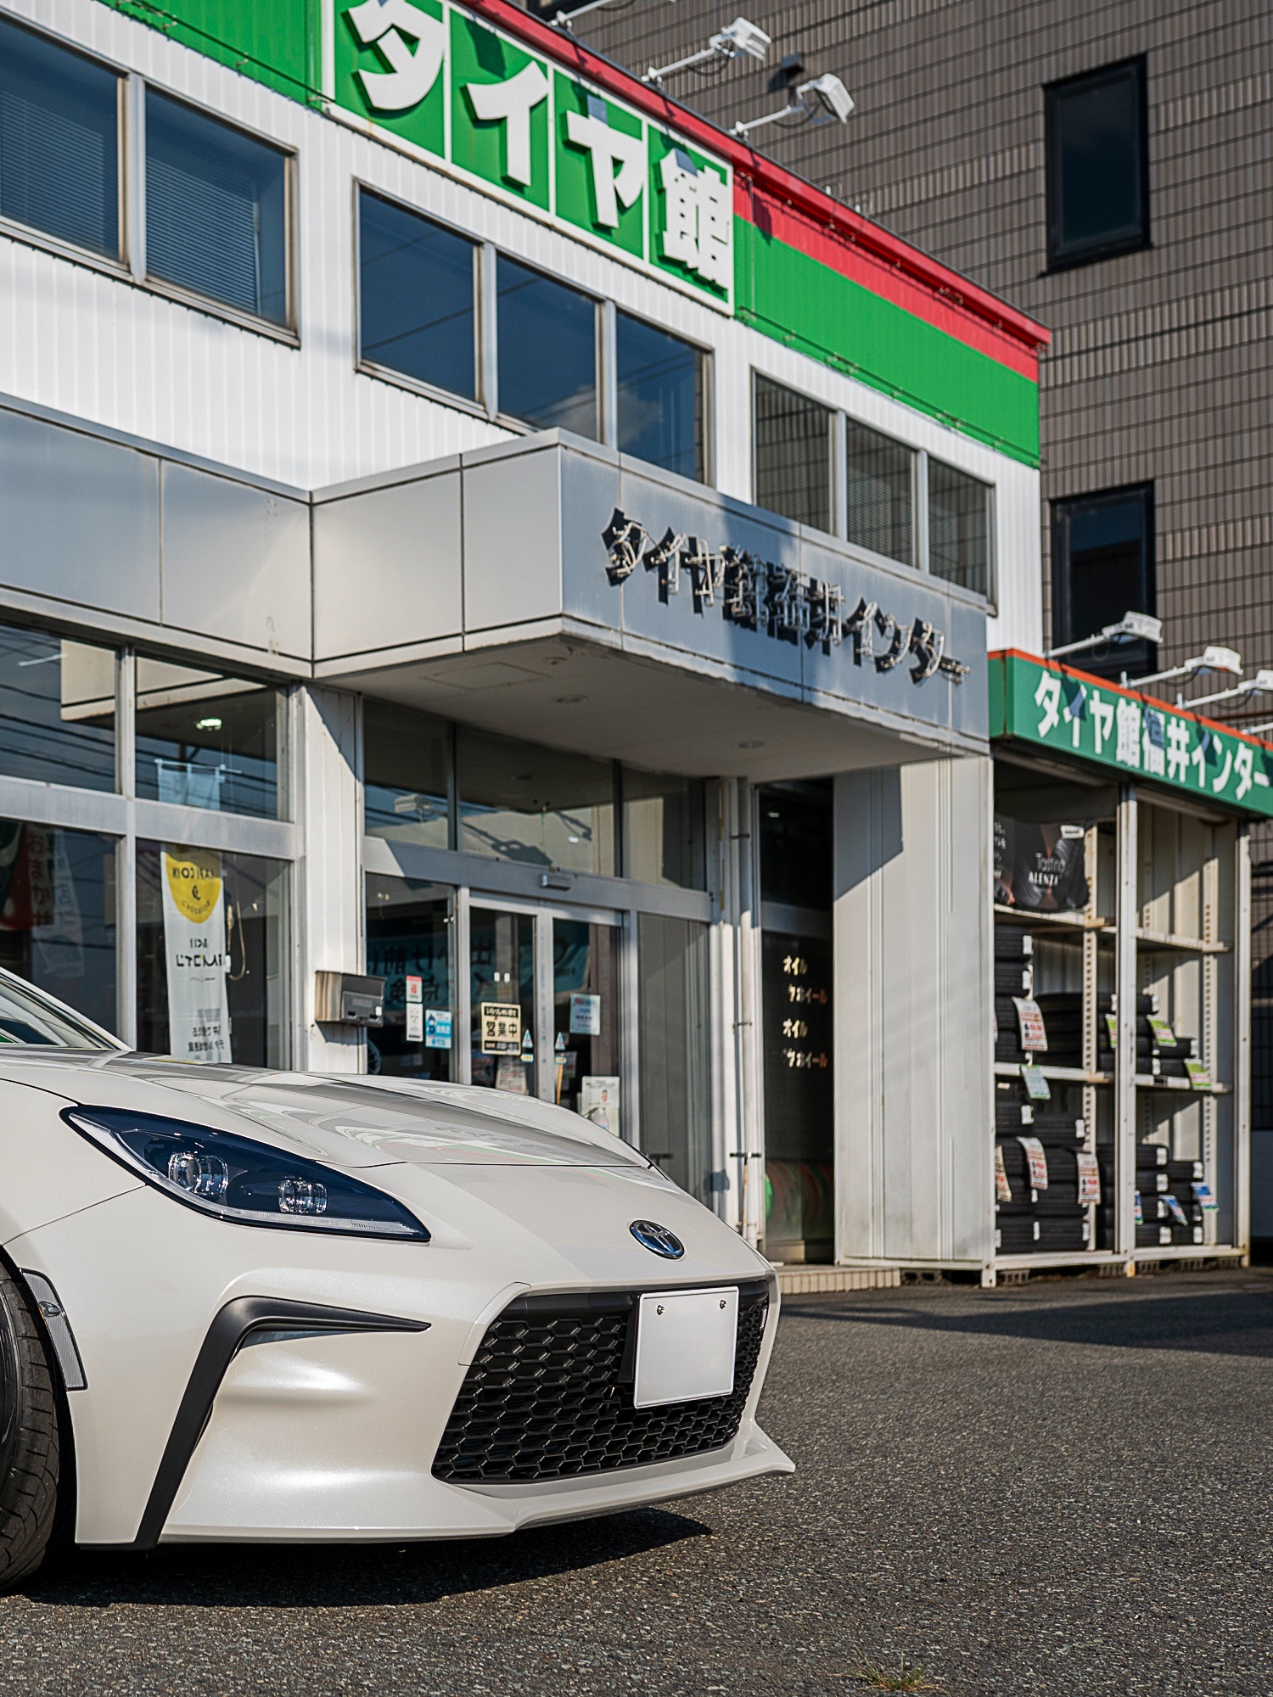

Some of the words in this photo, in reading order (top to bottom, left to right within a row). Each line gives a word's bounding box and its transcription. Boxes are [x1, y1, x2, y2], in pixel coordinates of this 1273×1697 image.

[343, 0, 729, 291] タイヤ館
[1035, 670, 1270, 800] タイヤ館福井インター
[487, 1020, 517, 1038] 営業中
